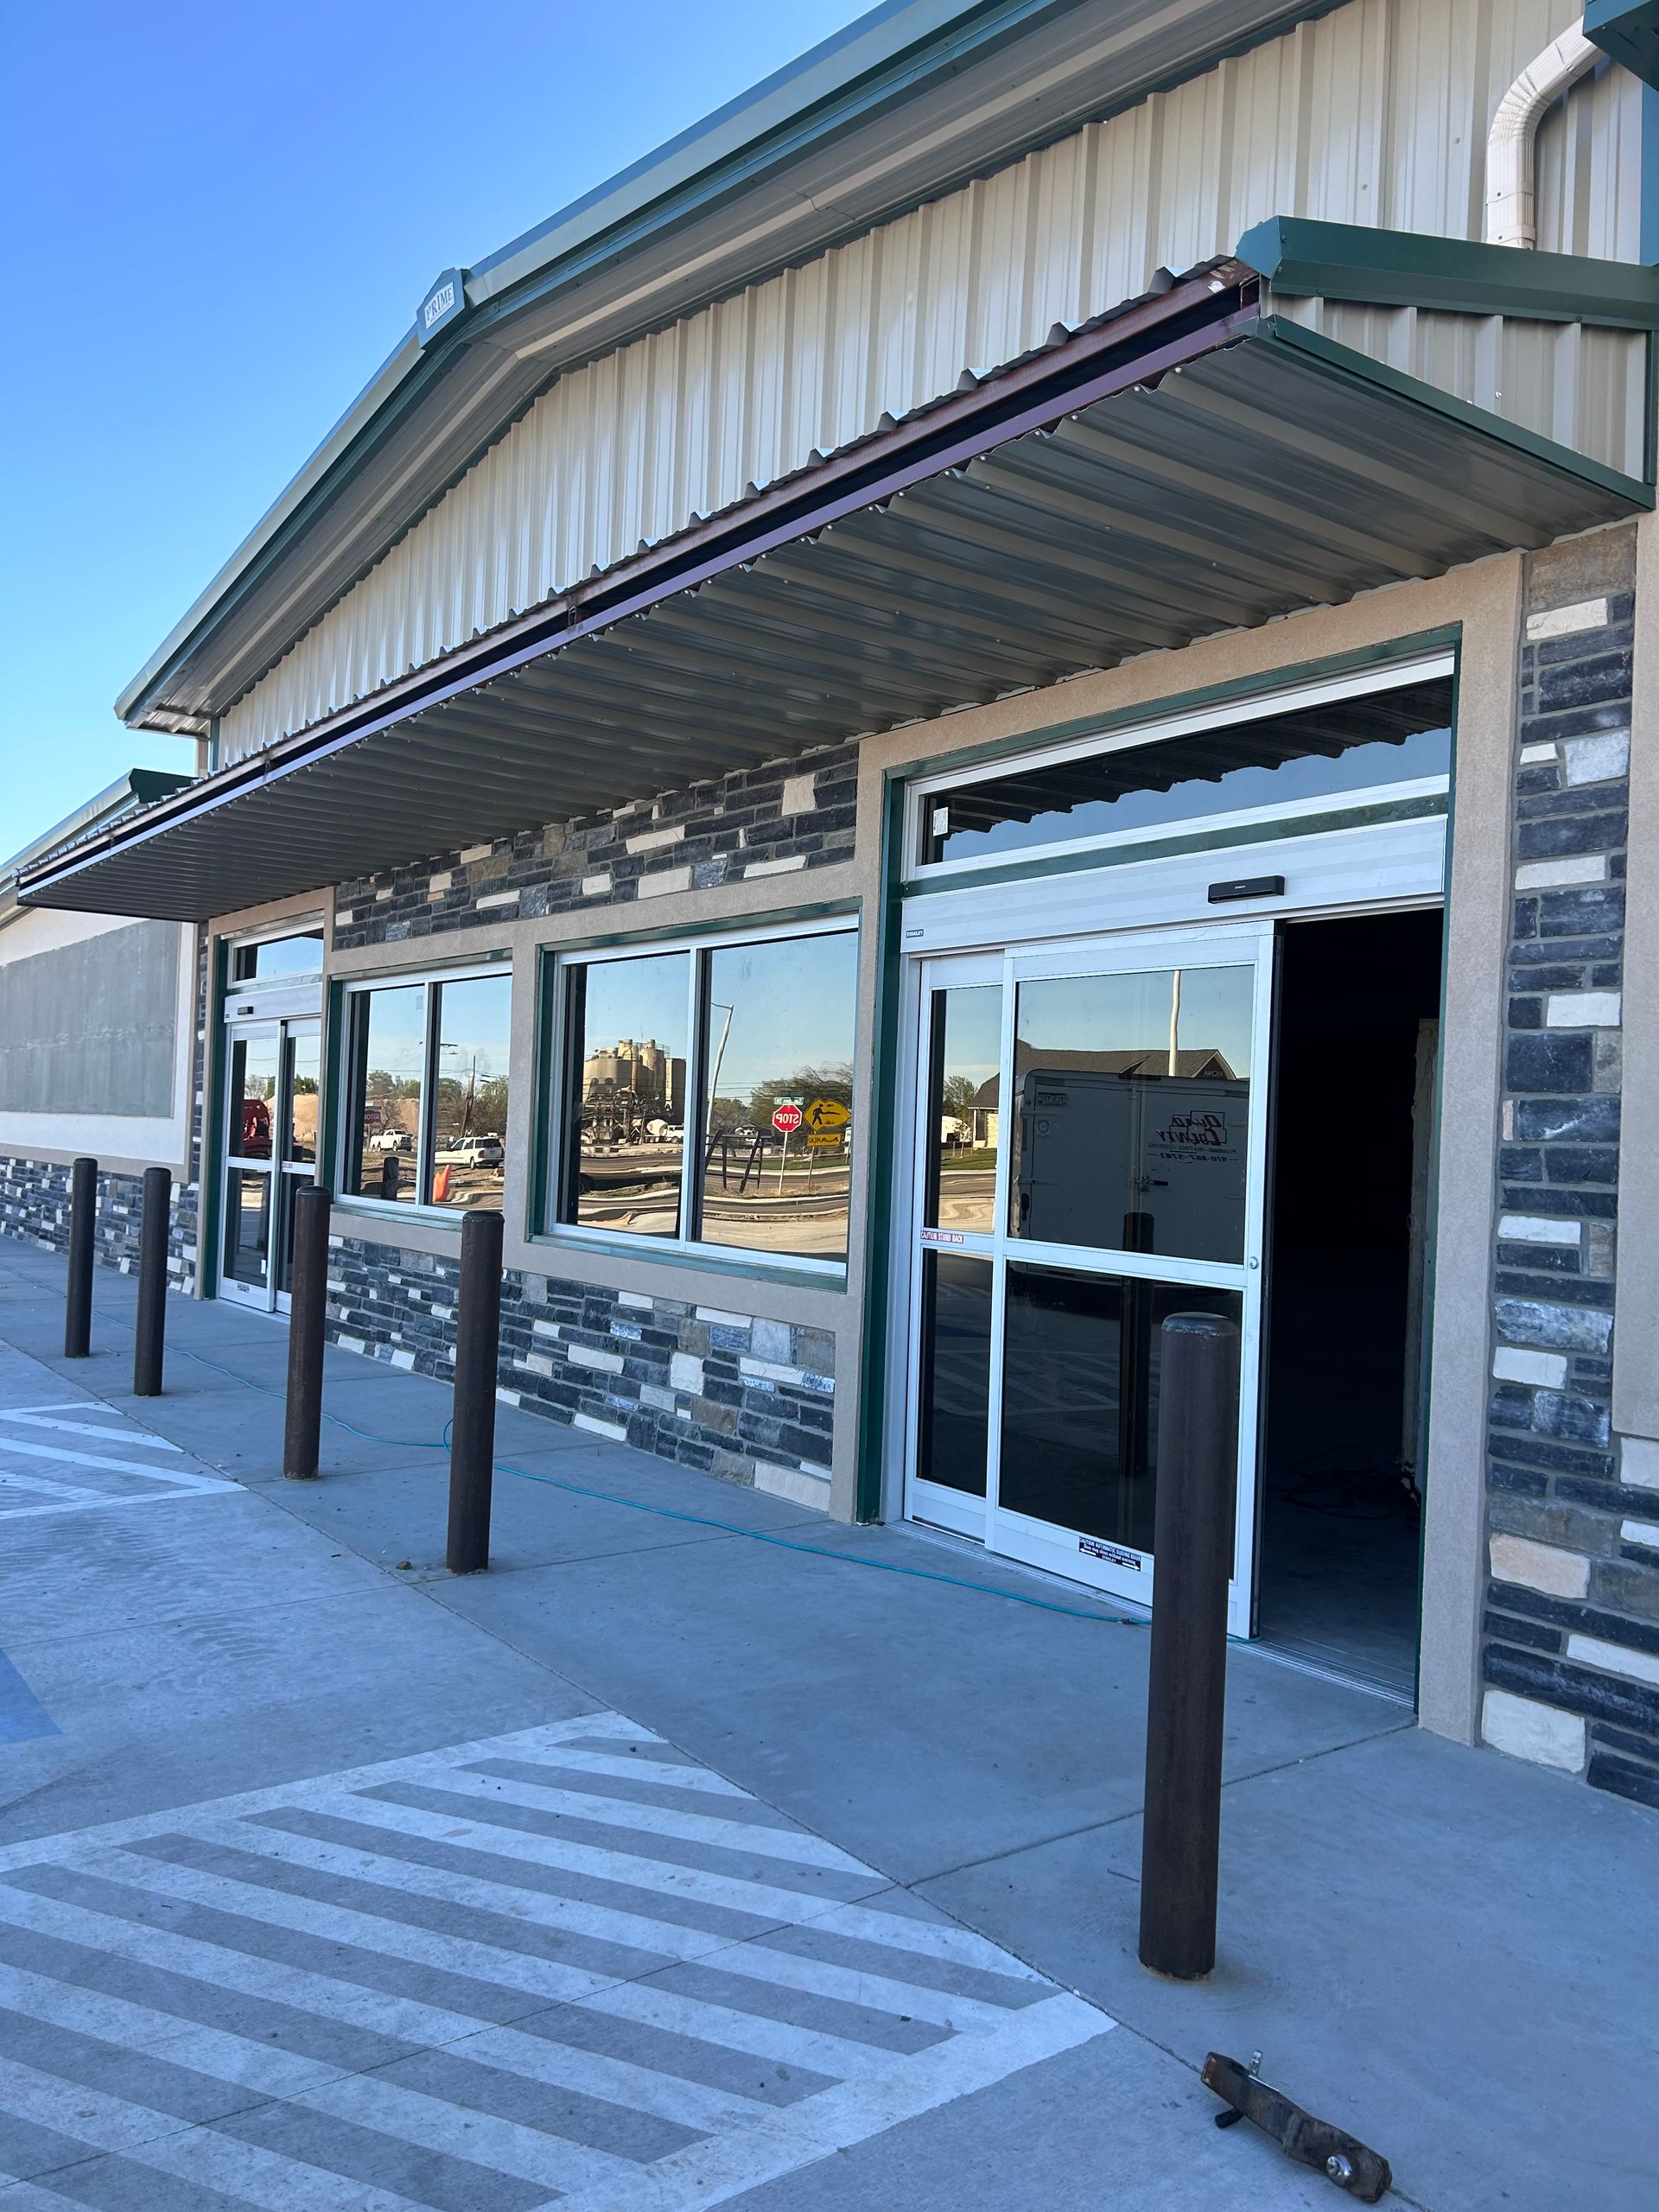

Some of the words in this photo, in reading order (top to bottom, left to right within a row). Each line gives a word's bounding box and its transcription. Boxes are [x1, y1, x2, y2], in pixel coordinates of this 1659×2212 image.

[426, 288, 453, 321] PRIME
[920, 1230, 937, 1240] CAUTION
[938, 1232, 951, 1242] STAND
[952, 1234, 963, 1243] BACK
